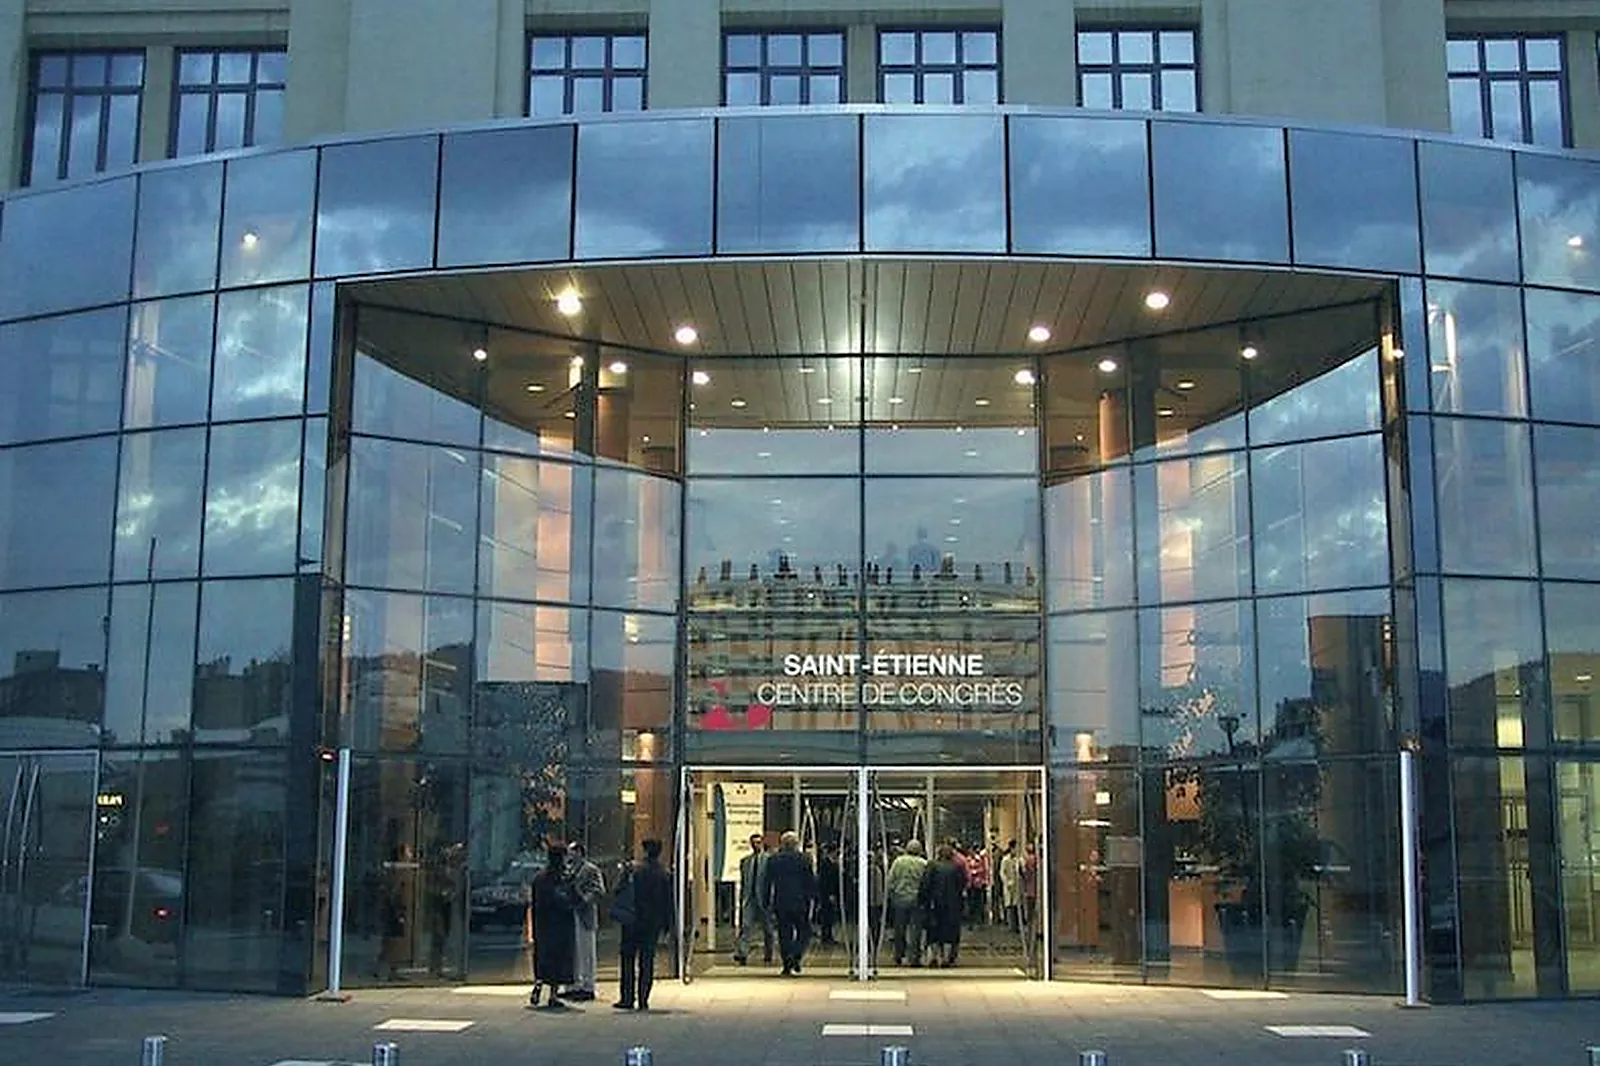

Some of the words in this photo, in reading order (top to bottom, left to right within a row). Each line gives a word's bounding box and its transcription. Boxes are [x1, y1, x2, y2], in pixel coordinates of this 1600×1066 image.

[783, 649, 983, 676] SAINT-ÉTIENNE
[757, 682, 857, 706] CENTRE
[862, 682, 896, 705] DE
[900, 678, 1023, 706] CONGRÈS
